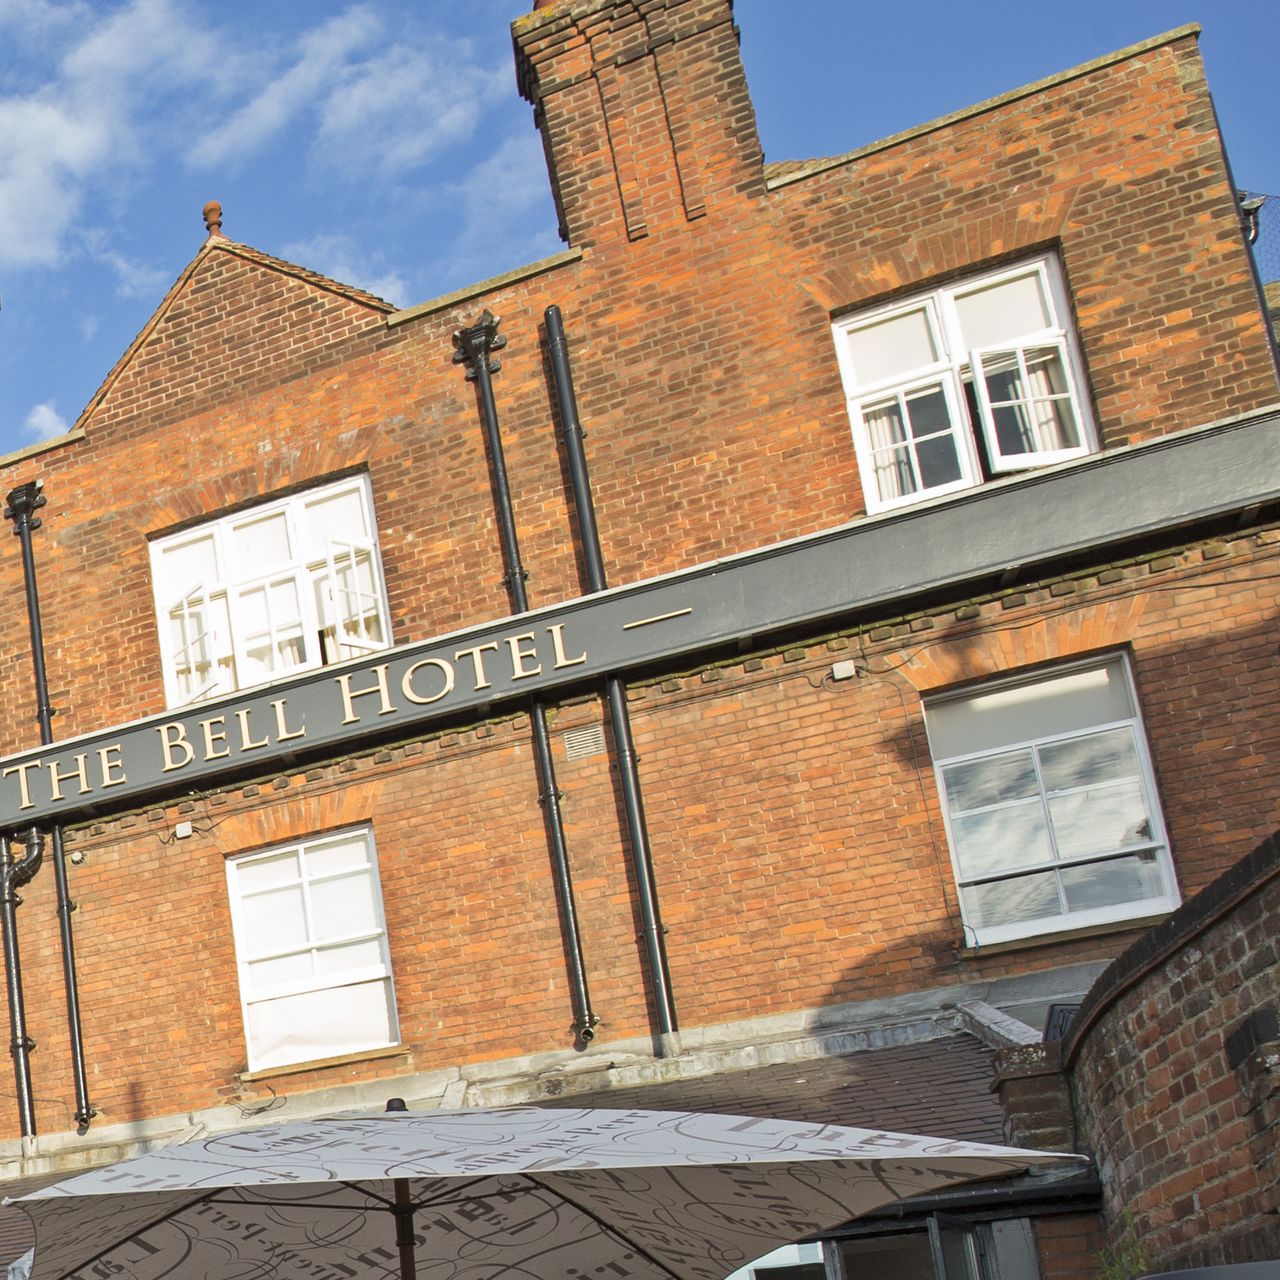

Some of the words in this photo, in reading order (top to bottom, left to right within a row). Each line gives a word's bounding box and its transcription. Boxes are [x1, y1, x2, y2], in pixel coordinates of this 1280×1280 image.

[3, 744, 127, 811] THE
[155, 699, 307, 773] BELL
[335, 623, 588, 726] HOTEL
